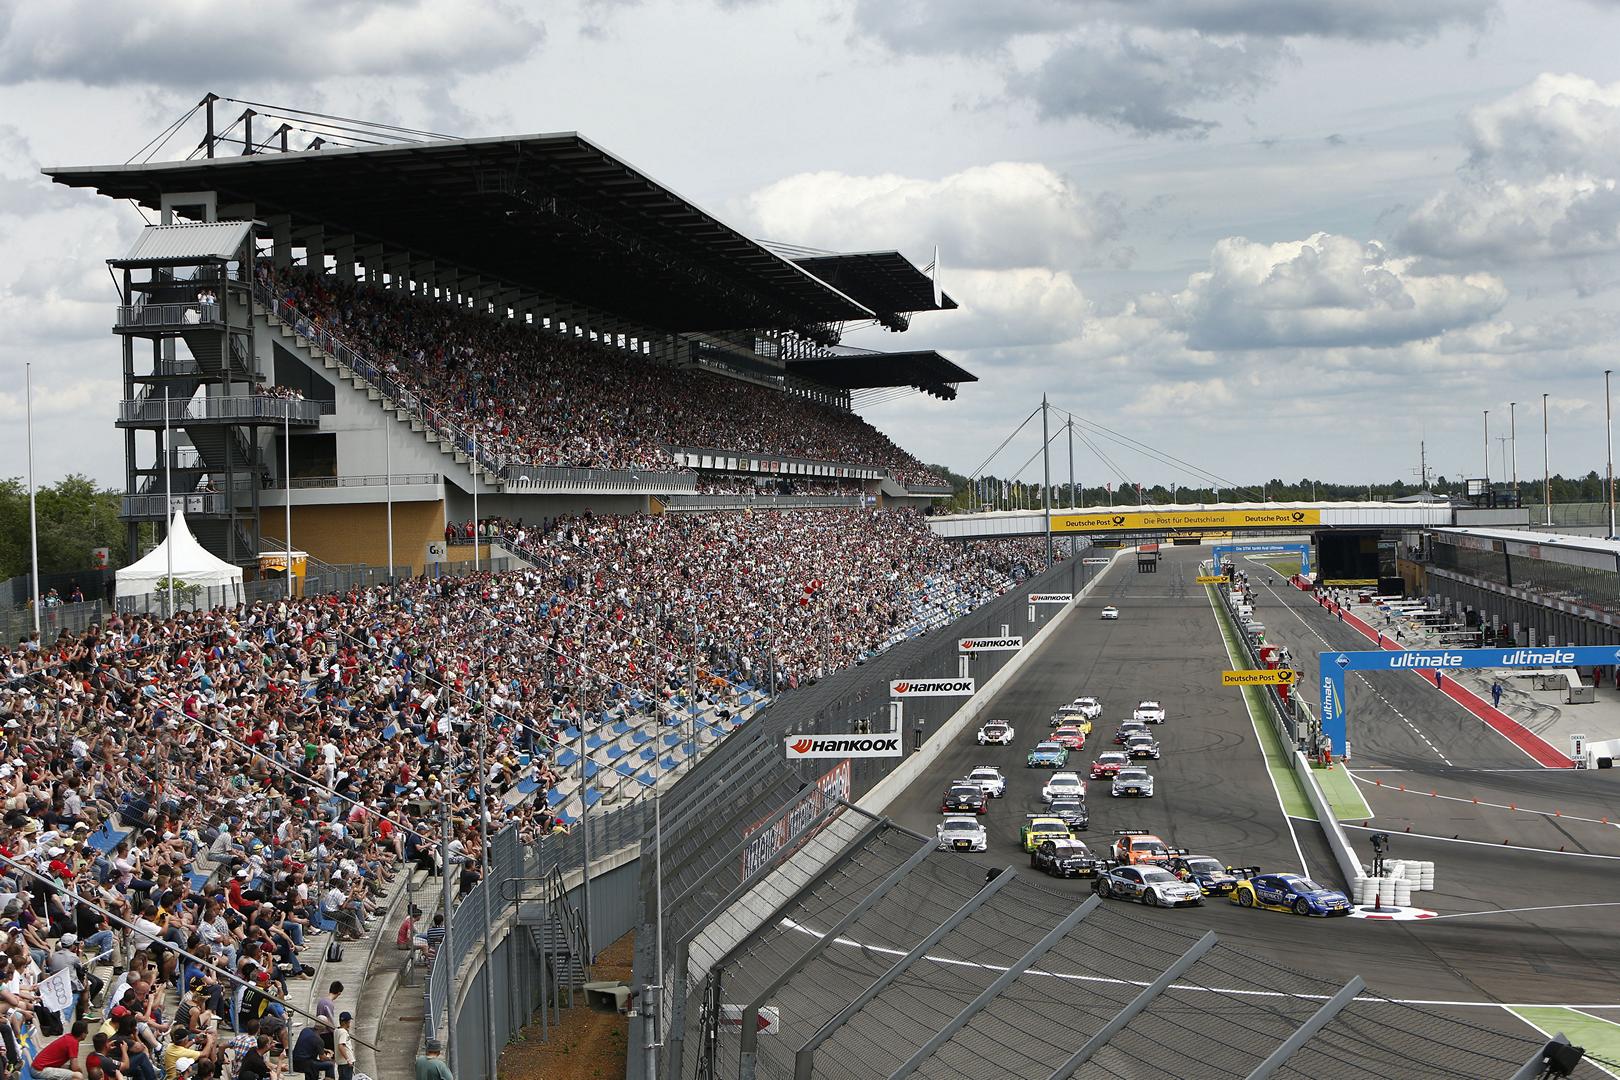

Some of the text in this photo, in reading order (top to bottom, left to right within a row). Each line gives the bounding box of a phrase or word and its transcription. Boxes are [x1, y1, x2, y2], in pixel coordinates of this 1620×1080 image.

[1065, 519, 1096, 527] Deutsche
[1172, 516, 1183, 524] für
[1390, 652, 1463, 668] ultimate
[1502, 649, 1575, 665] ultimate
[1224, 674, 1258, 682] Deutsche
[1323, 676, 1333, 720] ultimate
